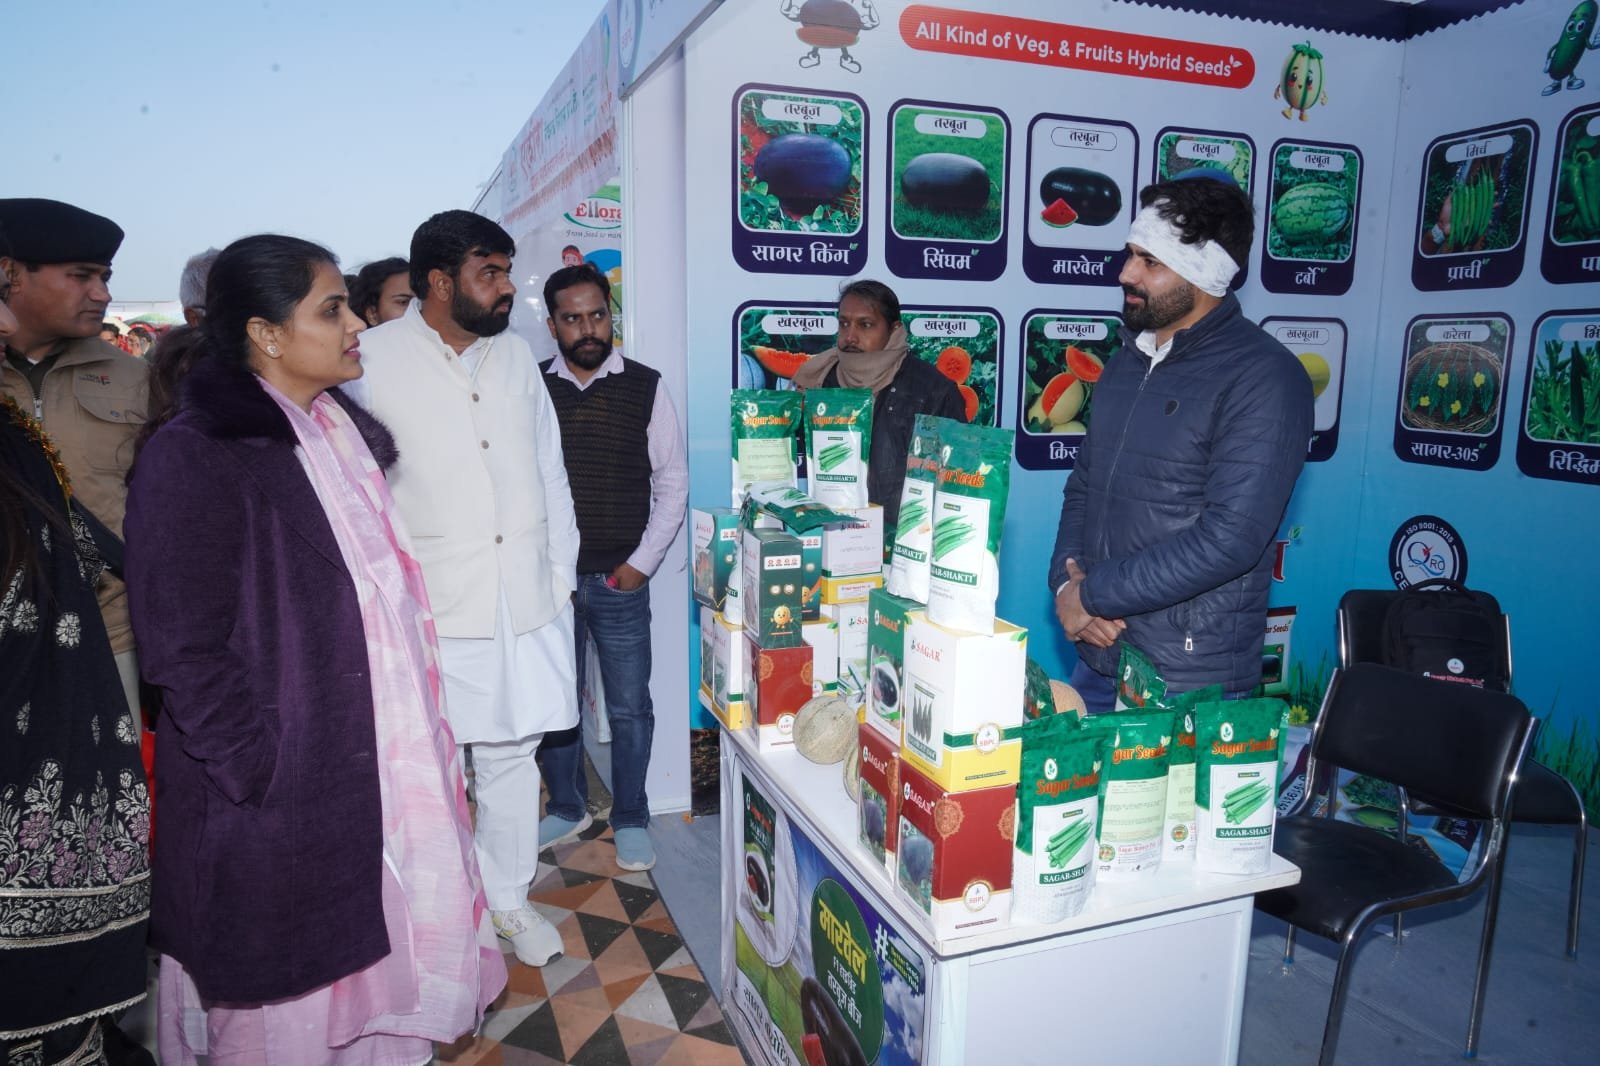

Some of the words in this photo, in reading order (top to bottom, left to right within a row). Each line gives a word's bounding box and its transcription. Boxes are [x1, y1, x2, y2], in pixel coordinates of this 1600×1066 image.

[915, 21, 940, 40] All
[946, 25, 987, 47] Kind
[992, 31, 1011, 49] of
[1015, 35, 1053, 58] Veg.
[1059, 40, 1070, 57] &
[1075, 42, 1123, 64] Fruits
[1127, 49, 1180, 72] Hybrid
[1185, 56, 1231, 77] Seeds
[784, 102, 821, 121] तरबूज
[934, 116, 968, 134] तरबूज
[1069, 130, 1099, 147] तरबूज
[1191, 142, 1220, 158] तरबूज
[1466, 140, 1492, 158] मिर्च
[1304, 153, 1330, 168] तरबूज
[751, 244, 804, 263] सागर
[808, 241, 850, 265] किंग
[922, 246, 972, 270] सिंघम
[1052, 255, 1105, 277] मारवेल
[1448, 259, 1482, 283] प्राची
[777, 315, 824, 332] खरबूजा
[923, 320, 967, 337] खरबूजा
[1057, 323, 1096, 338] खरबूजा
[1442, 329, 1472, 340] करेला
[955, 467, 985, 488] Seeds
[916, 642, 941, 662] SAGAR
[1212, 741, 1246, 757] Sagar
[1036, 778, 1070, 797] Sagar
[819, 897, 867, 985] मारवेल
[875, 922, 889, 962] #
